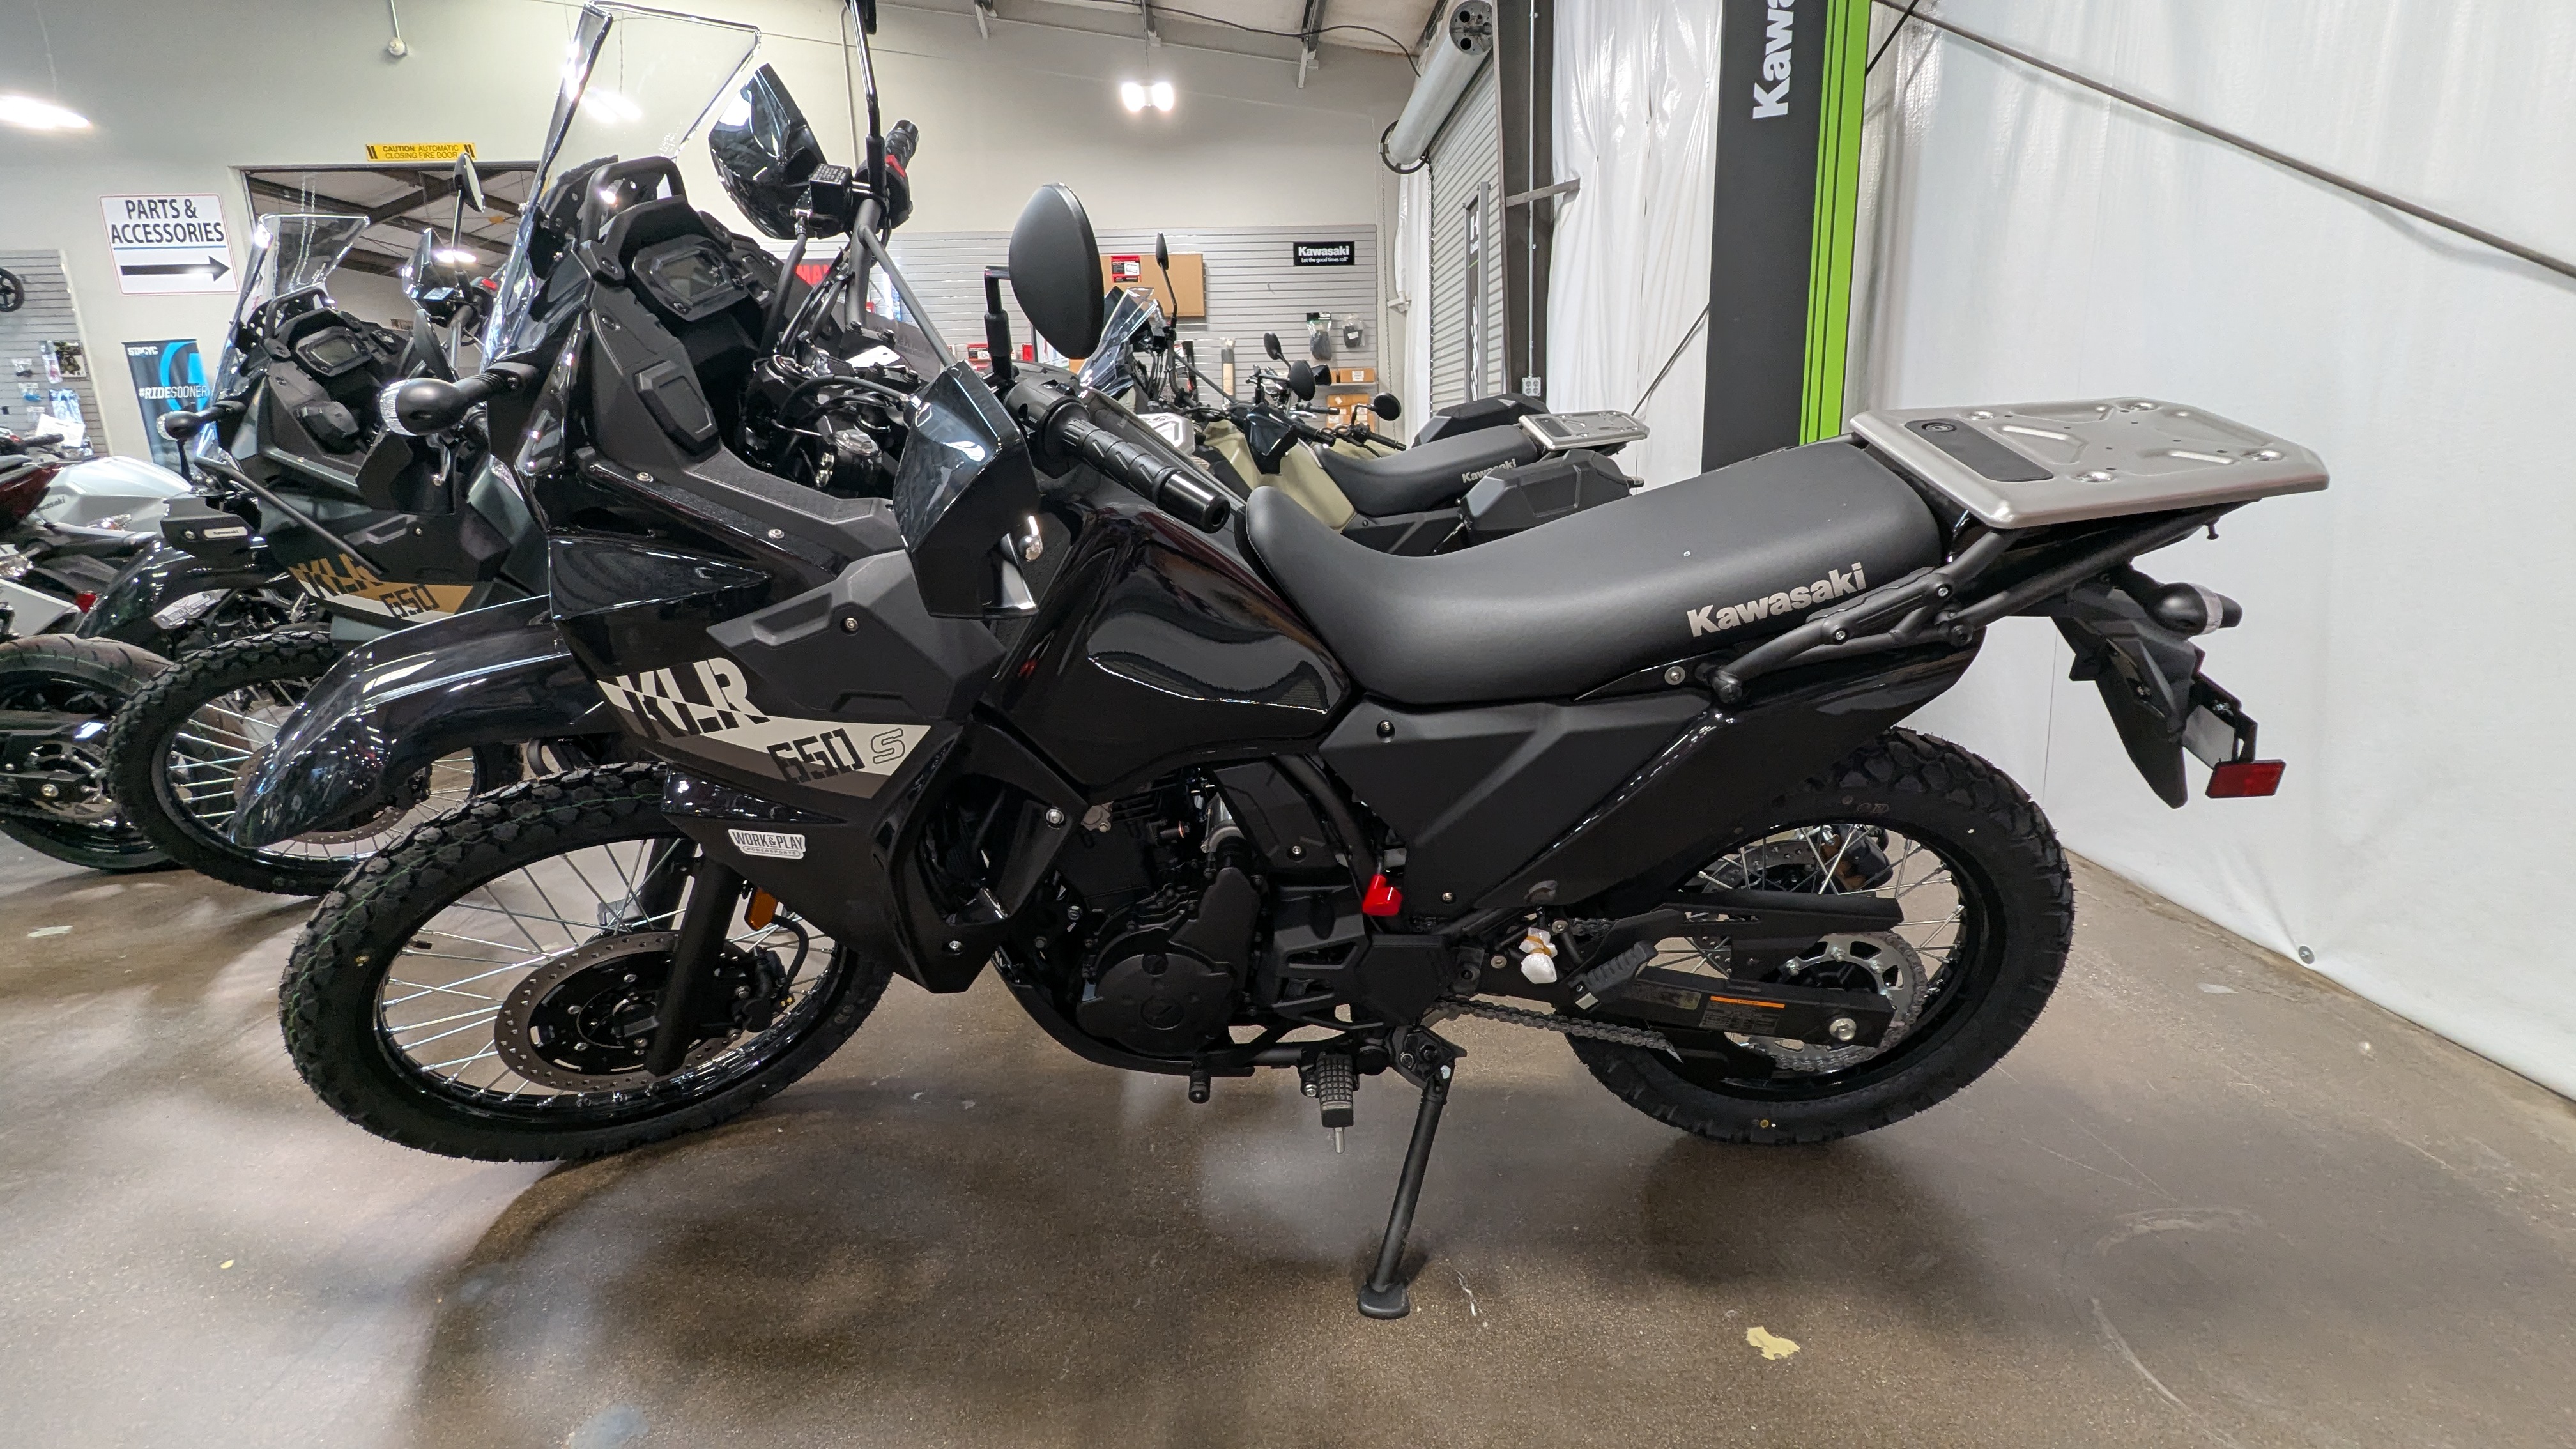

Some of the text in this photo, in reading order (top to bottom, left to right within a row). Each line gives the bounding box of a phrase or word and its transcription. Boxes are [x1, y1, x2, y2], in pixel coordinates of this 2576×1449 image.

[1752, 0, 1795, 119] Kaw
[125, 198, 199, 220] PARTS &
[111, 222, 225, 244] ACCESSORIES
[1298, 245, 1350, 256] Kawasaki
[139, 385, 208, 399] #RIDESOONER
[379, 582, 441, 620] 650
[1687, 562, 1866, 638] Kawasaki
[615, 657, 772, 740] KLR
[766, 728, 906, 784] 650 S
[746, 847, 797, 855] POWERSPORTS
